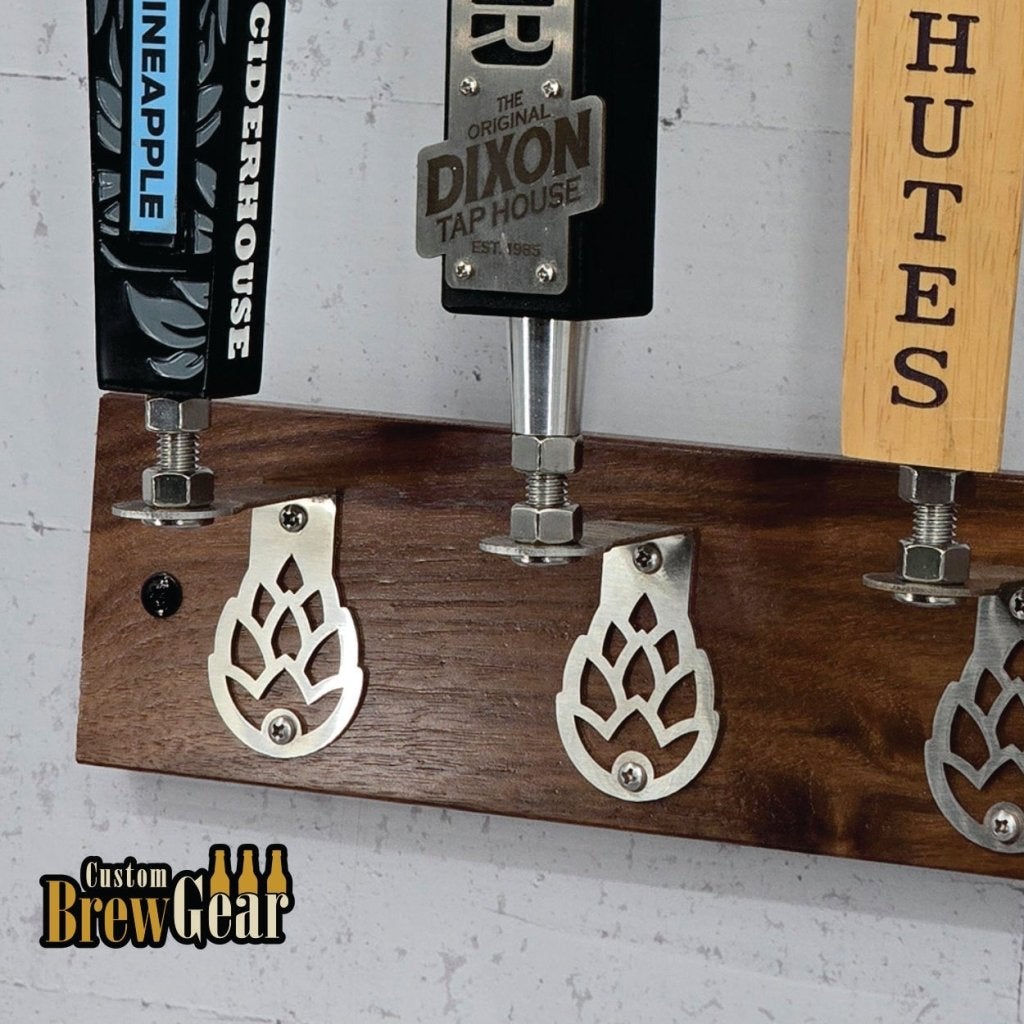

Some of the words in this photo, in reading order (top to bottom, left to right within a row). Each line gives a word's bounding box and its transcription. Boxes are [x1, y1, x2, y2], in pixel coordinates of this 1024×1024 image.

[468, 104, 552, 139] ORIGINAL
[497, 90, 524, 113] THE
[228, 2, 270, 359] CIDERHOUSE
[425, 108, 592, 216] DIXON
[436, 207, 486, 243] TAP
[492, 176, 581, 226] HOUSE
